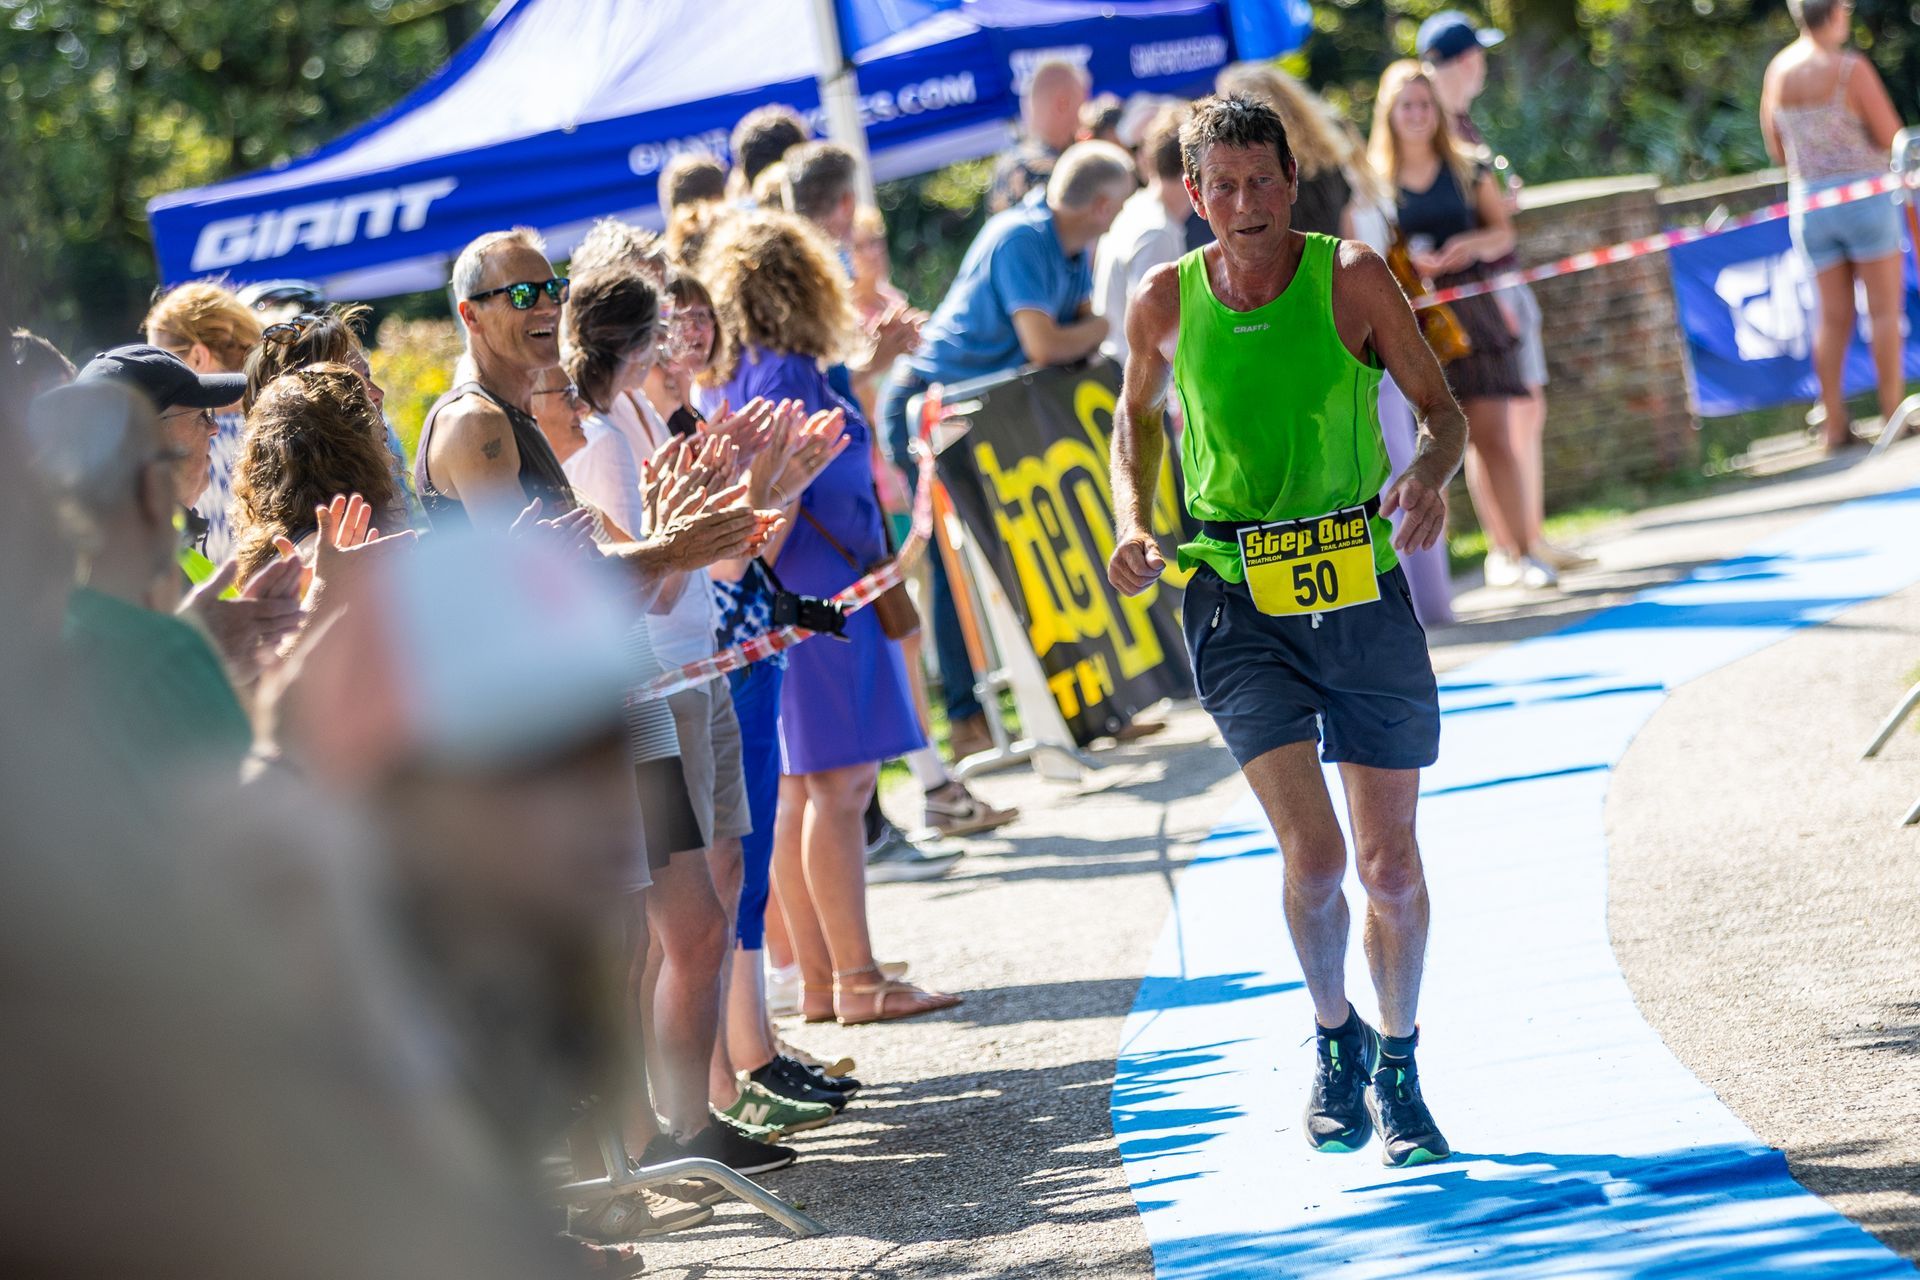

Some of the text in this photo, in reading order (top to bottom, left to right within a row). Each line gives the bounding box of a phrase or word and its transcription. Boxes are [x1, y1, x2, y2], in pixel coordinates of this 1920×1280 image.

[189, 175, 459, 272] GIANT
[1233, 324, 1263, 334] CRAFT
[1246, 518, 1364, 557] Step One
[1320, 538, 1364, 552] TRAIL AND RUN
[1247, 554, 1282, 566] TRIATHLON
[1292, 559, 1338, 607] 50
[738, 1102, 771, 1126] N
